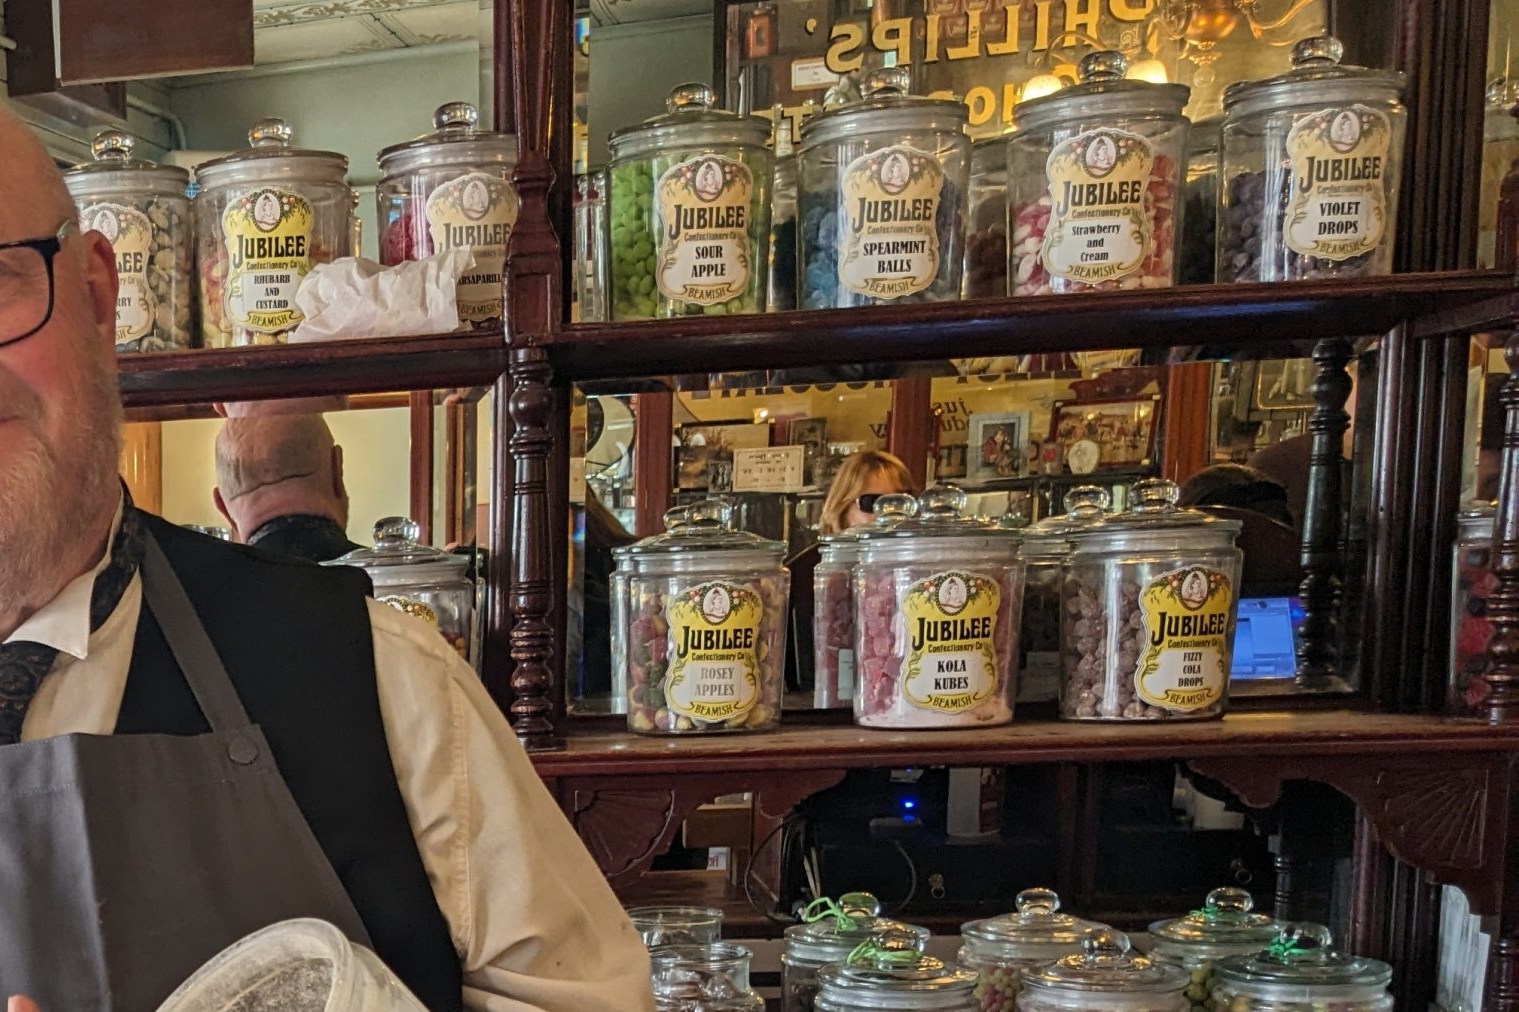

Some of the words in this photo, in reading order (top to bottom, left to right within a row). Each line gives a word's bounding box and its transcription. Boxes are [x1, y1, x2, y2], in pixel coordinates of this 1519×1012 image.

[1299, 155, 1381, 192] JUBILEE
[1056, 181, 1141, 218] JUBILEE
[852, 198, 932, 233] JUBILEE
[1320, 201, 1361, 216] VIOLET
[669, 204, 744, 240] JUBILEE
[1317, 220, 1359, 235] DROPS
[1071, 223, 1121, 236] Strawberry
[863, 240, 926, 256] SPEARMINT
[1087, 237, 1105, 248] and
[1319, 240, 1360, 253] BEAMISH
[232, 234, 306, 269] JUBILEE
[695, 246, 723, 259] SOUR
[1080, 250, 1109, 262] Cream
[246, 261, 288, 271] Confectionery
[690, 264, 726, 279] APPLE
[877, 259, 911, 273] BALLS
[1073, 264, 1116, 276] BEAMISH
[254, 274, 291, 285] RHUBARB
[870, 280, 909, 293] BEAMISH
[264, 287, 280, 297] AND
[688, 286, 726, 299] BEAMISH
[256, 300, 289, 310] CUSTARD
[251, 314, 288, 326] BEAMISH
[912, 616, 991, 651] JUBILEE
[1151, 612, 1225, 646] JUBILEE
[677, 626, 753, 659] JUBILEE
[1183, 652, 1202, 662] FIZZY
[700, 666, 735, 680] ROSEY
[937, 659, 967, 674] KOLA
[1183, 665, 1201, 674] COLA
[934, 676, 969, 690] KUBES
[1178, 677, 1204, 687] DROPS
[695, 682, 735, 697] APPLES
[933, 695, 972, 709] BEAMISH
[1169, 692, 1206, 704] BEAMISH
[694, 702, 734, 716] BEAMISH
